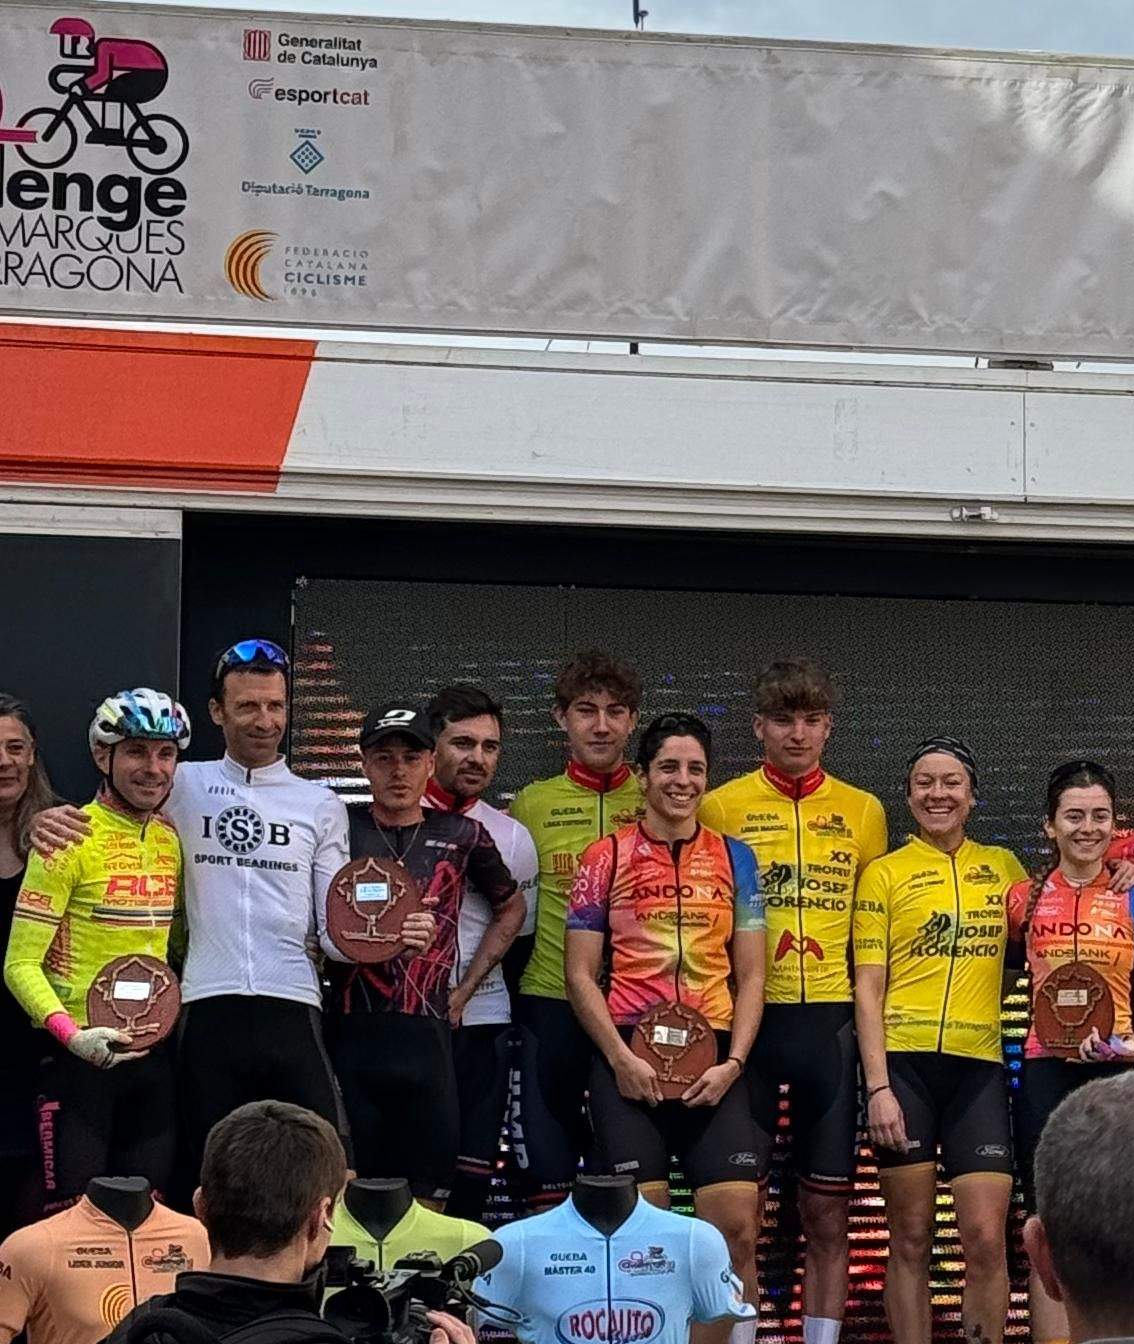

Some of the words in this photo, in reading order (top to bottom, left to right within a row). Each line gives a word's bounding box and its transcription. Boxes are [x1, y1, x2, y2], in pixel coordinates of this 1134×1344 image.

[278, 33, 362, 52] Generalitat
[277, 50, 296, 64] de
[301, 51, 378, 71] Catalunya
[274, 88, 370, 106] esportcat
[0, 158, 188, 232] enge
[241, 181, 304, 197] Diputació
[305, 184, 370, 201] Tarragona
[0, 250, 185, 294] RAGONA
[284, 258, 368, 271] CATALANA
[284, 272, 367, 287] CICLISME
[194, 853, 232, 866] SPORT
[236, 857, 299, 872] BEARINGS
[631, 884, 724, 900] ANDONA
[799, 879, 849, 894] JOSEP
[766, 896, 846, 912] ORENCIO
[956, 924, 1003, 939] JOSEP
[550, 1253, 588, 1262] GUEBA
[568, 1309, 655, 1340] ROCAUTO
